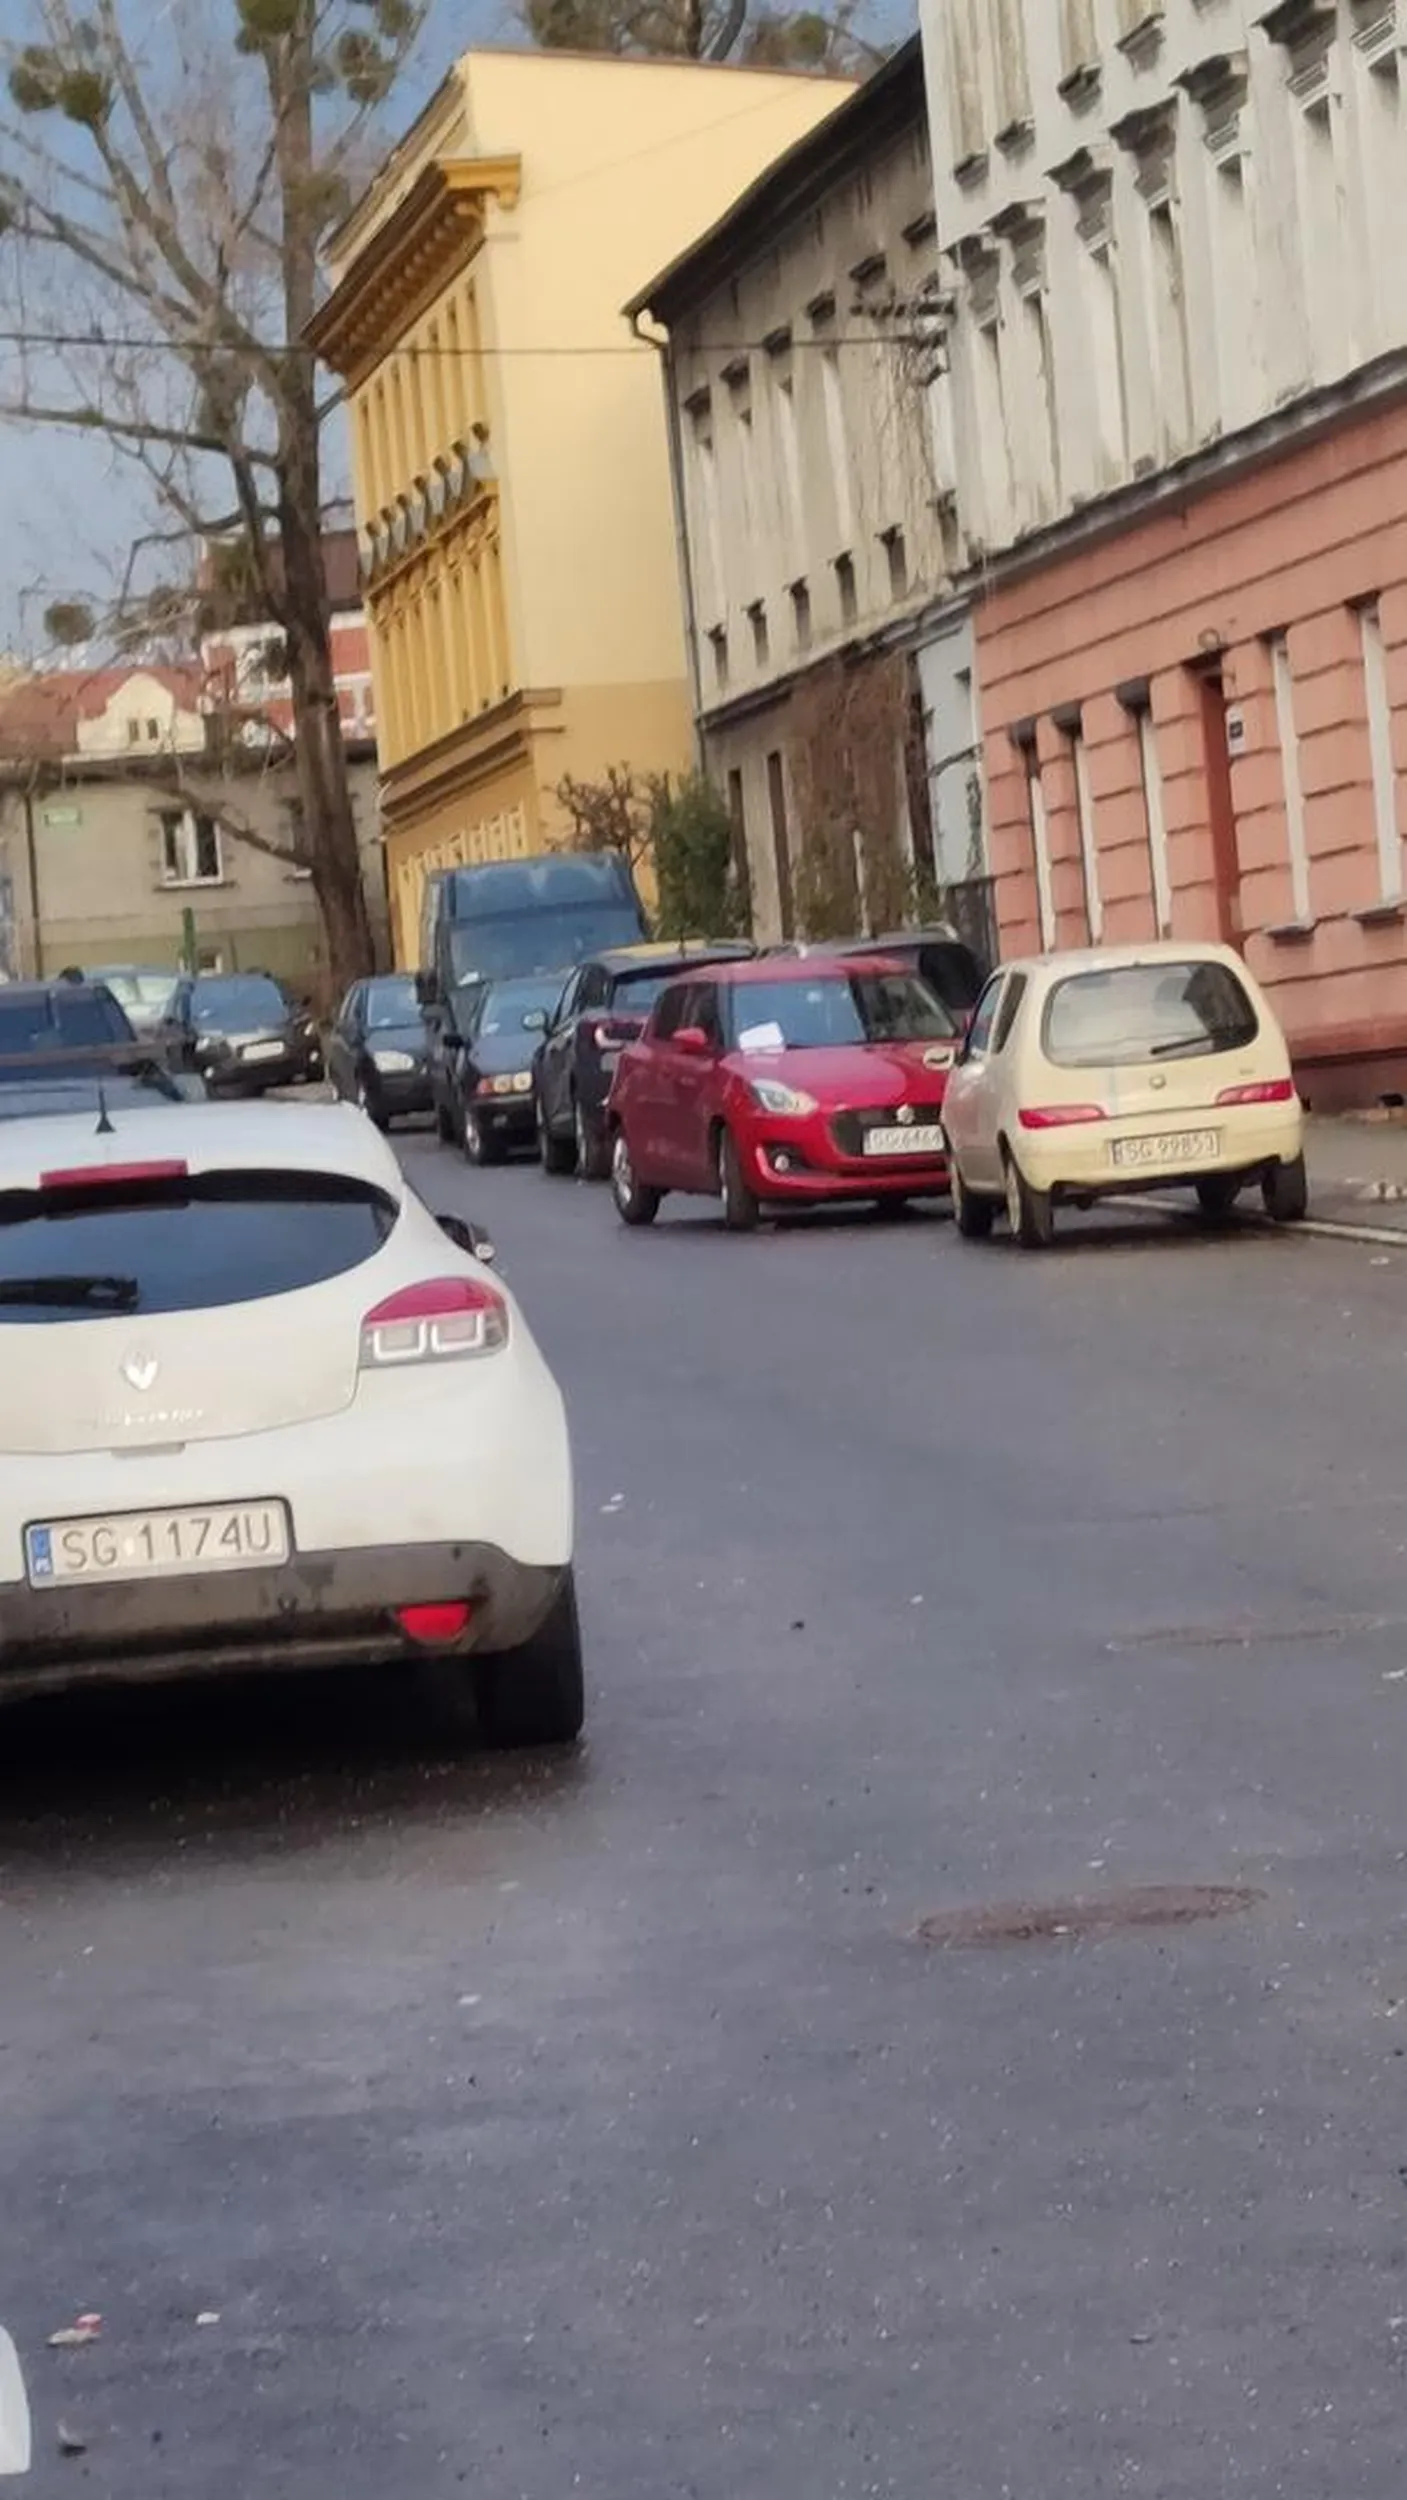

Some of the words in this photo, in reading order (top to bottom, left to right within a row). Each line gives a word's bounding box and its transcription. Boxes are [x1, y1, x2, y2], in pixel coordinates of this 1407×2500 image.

[1126, 1140, 1153, 1161] SG
[61, 1526, 118, 1570] SG
[138, 1512, 270, 1561] 1174U
